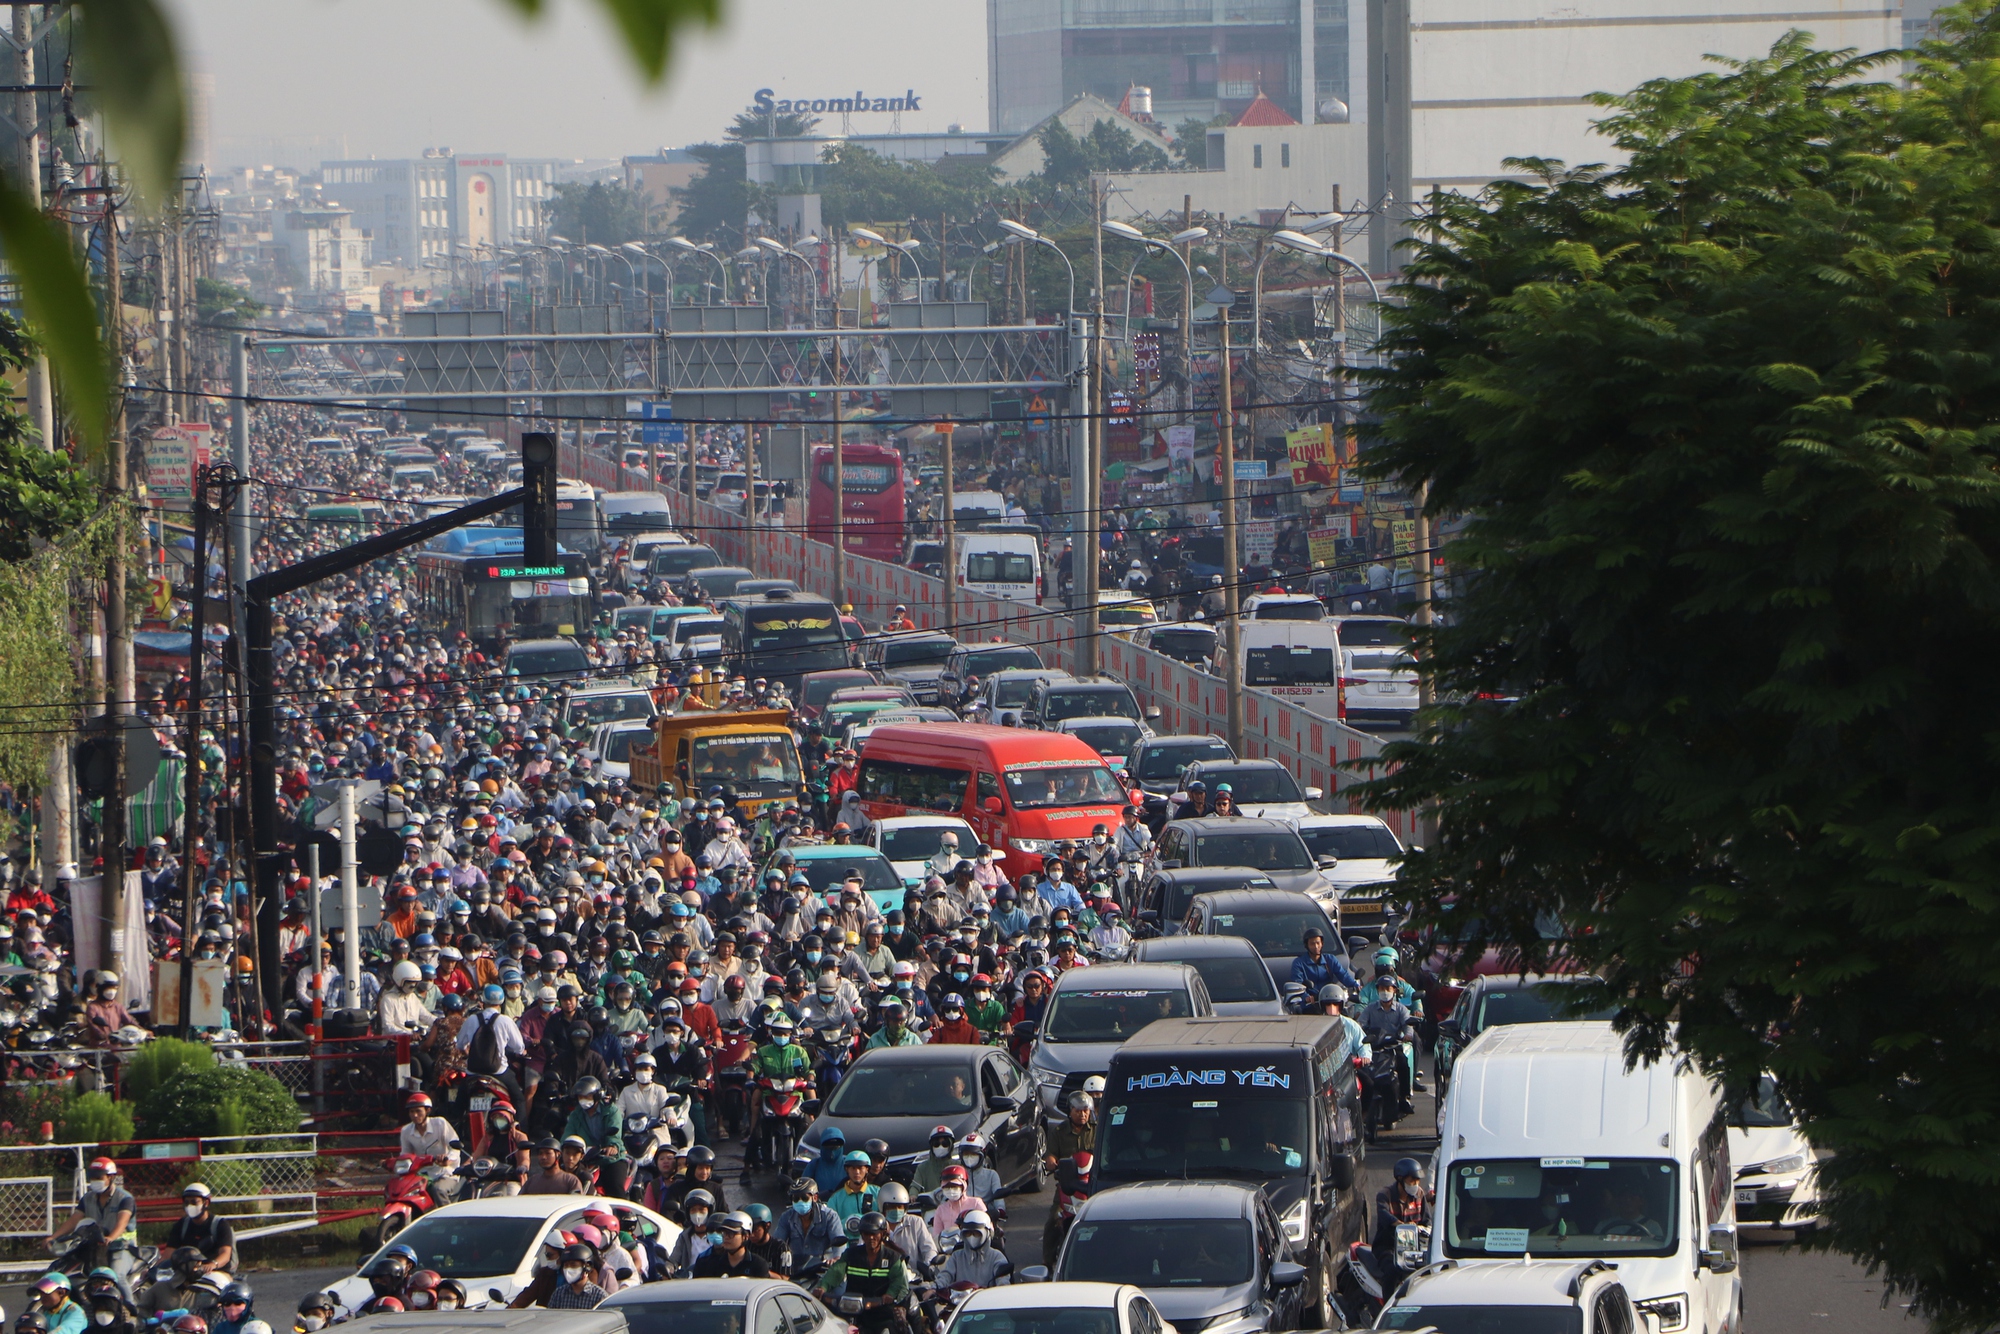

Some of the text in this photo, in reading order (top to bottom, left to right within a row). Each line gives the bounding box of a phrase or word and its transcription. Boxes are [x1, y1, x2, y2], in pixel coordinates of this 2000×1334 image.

[753, 88, 922, 115] Sacombank
[535, 582, 549, 595] 19
[878, 716, 905, 724] VINASUN
[1046, 808, 1116, 821] PHƯƠNG TRANG
[1127, 1065, 1290, 1092] HOÀNG YẾN
